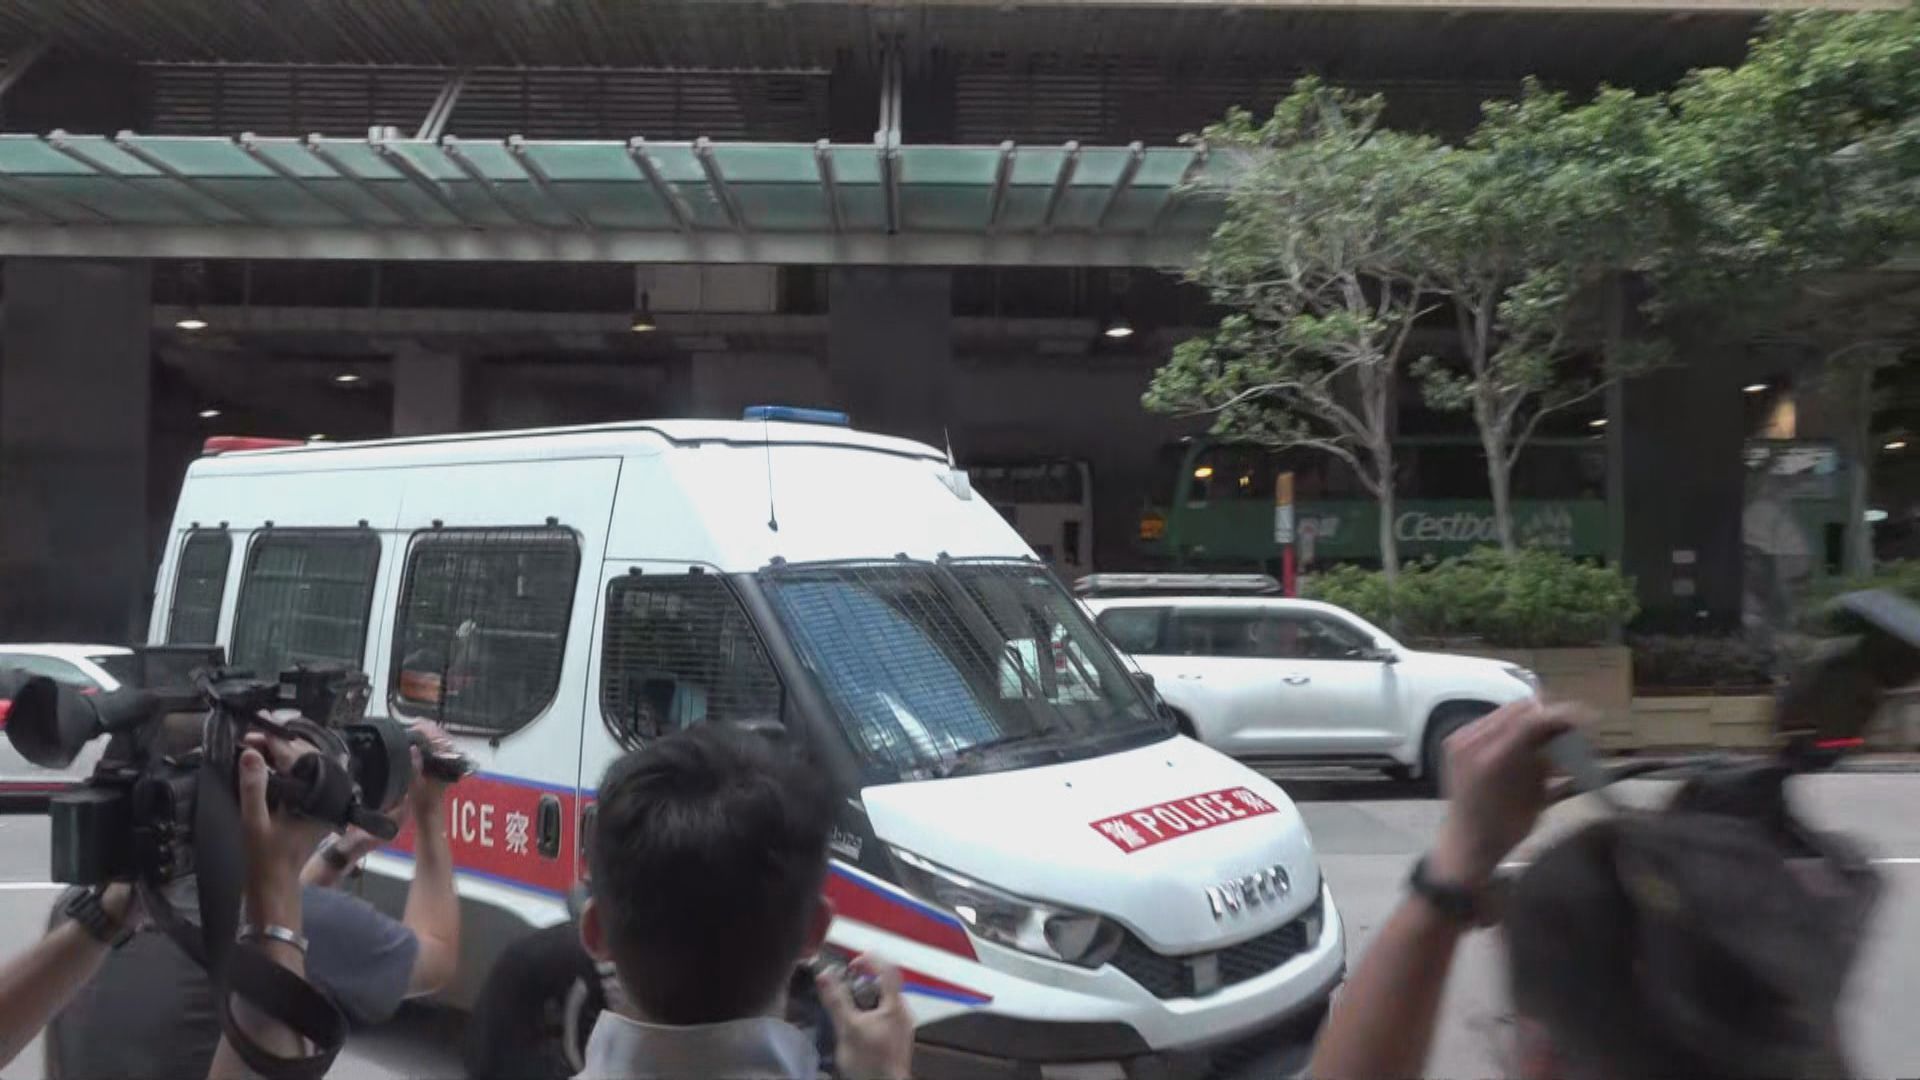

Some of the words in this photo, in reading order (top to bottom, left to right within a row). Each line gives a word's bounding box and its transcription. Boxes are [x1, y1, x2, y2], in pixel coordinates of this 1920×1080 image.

[444, 798, 494, 847] ICE
[506, 812, 529, 855] 察
[1131, 793, 1246, 839] POLICE
[1206, 864, 1290, 919] IVECO
